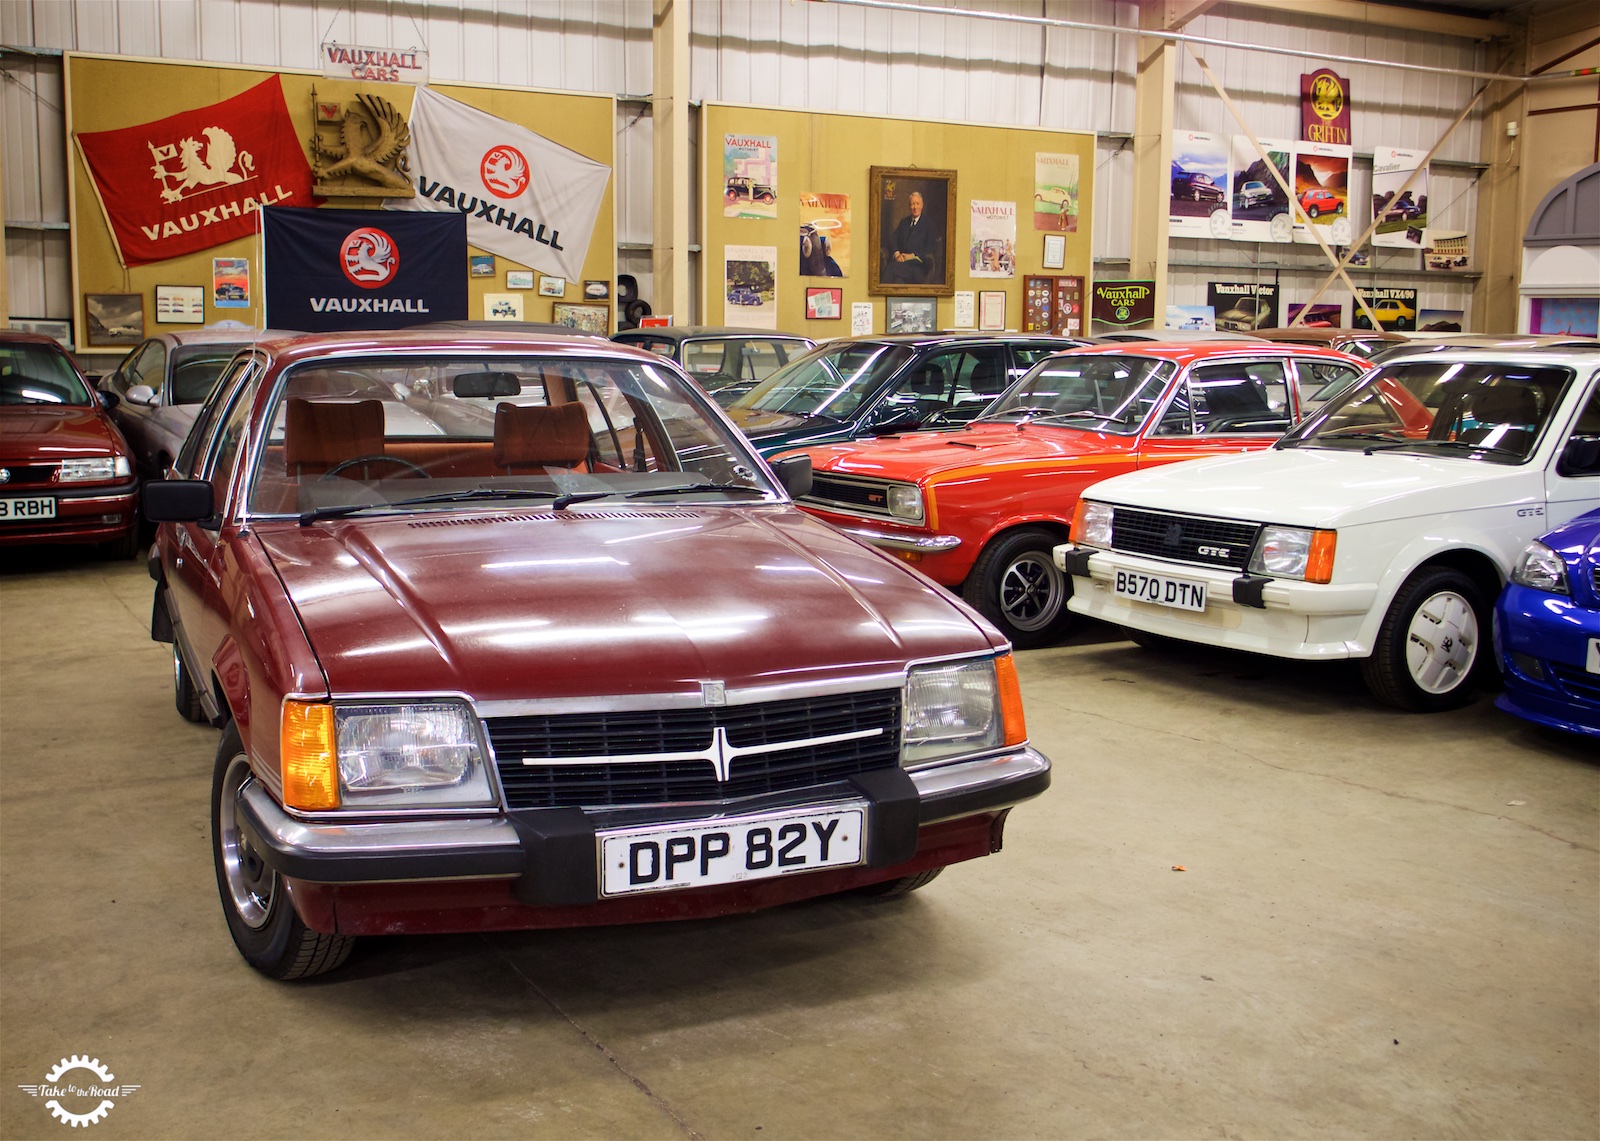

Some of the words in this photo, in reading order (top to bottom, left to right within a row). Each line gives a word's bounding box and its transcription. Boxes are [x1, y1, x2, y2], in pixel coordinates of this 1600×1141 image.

[327, 47, 422, 70] VAUXHALL
[352, 67, 399, 82] CARS
[725, 138, 771, 149] VAUXHALL
[1374, 163, 1401, 172] Cavalier
[141, 185, 293, 241] VAUXHALL
[419, 175, 564, 252] VAUXHALL
[970, 206, 1015, 216] VAUXHALL
[1097, 286, 1150, 299] Vauxhall
[1215, 284, 1250, 295] Vauxhall
[1250, 285, 1275, 296] Vctor
[310, 298, 430, 313] VAUXHALL
[1111, 299, 1135, 307] CARS
[14, 499, 53, 517] RBH
[1517, 507, 1545, 518] GTE
[1197, 545, 1231, 558] GTE
[1116, 571, 1160, 600] B570
[1165, 581, 1204, 608] DTN
[629, 832, 730, 885] DPP
[745, 818, 841, 871] 82Y
